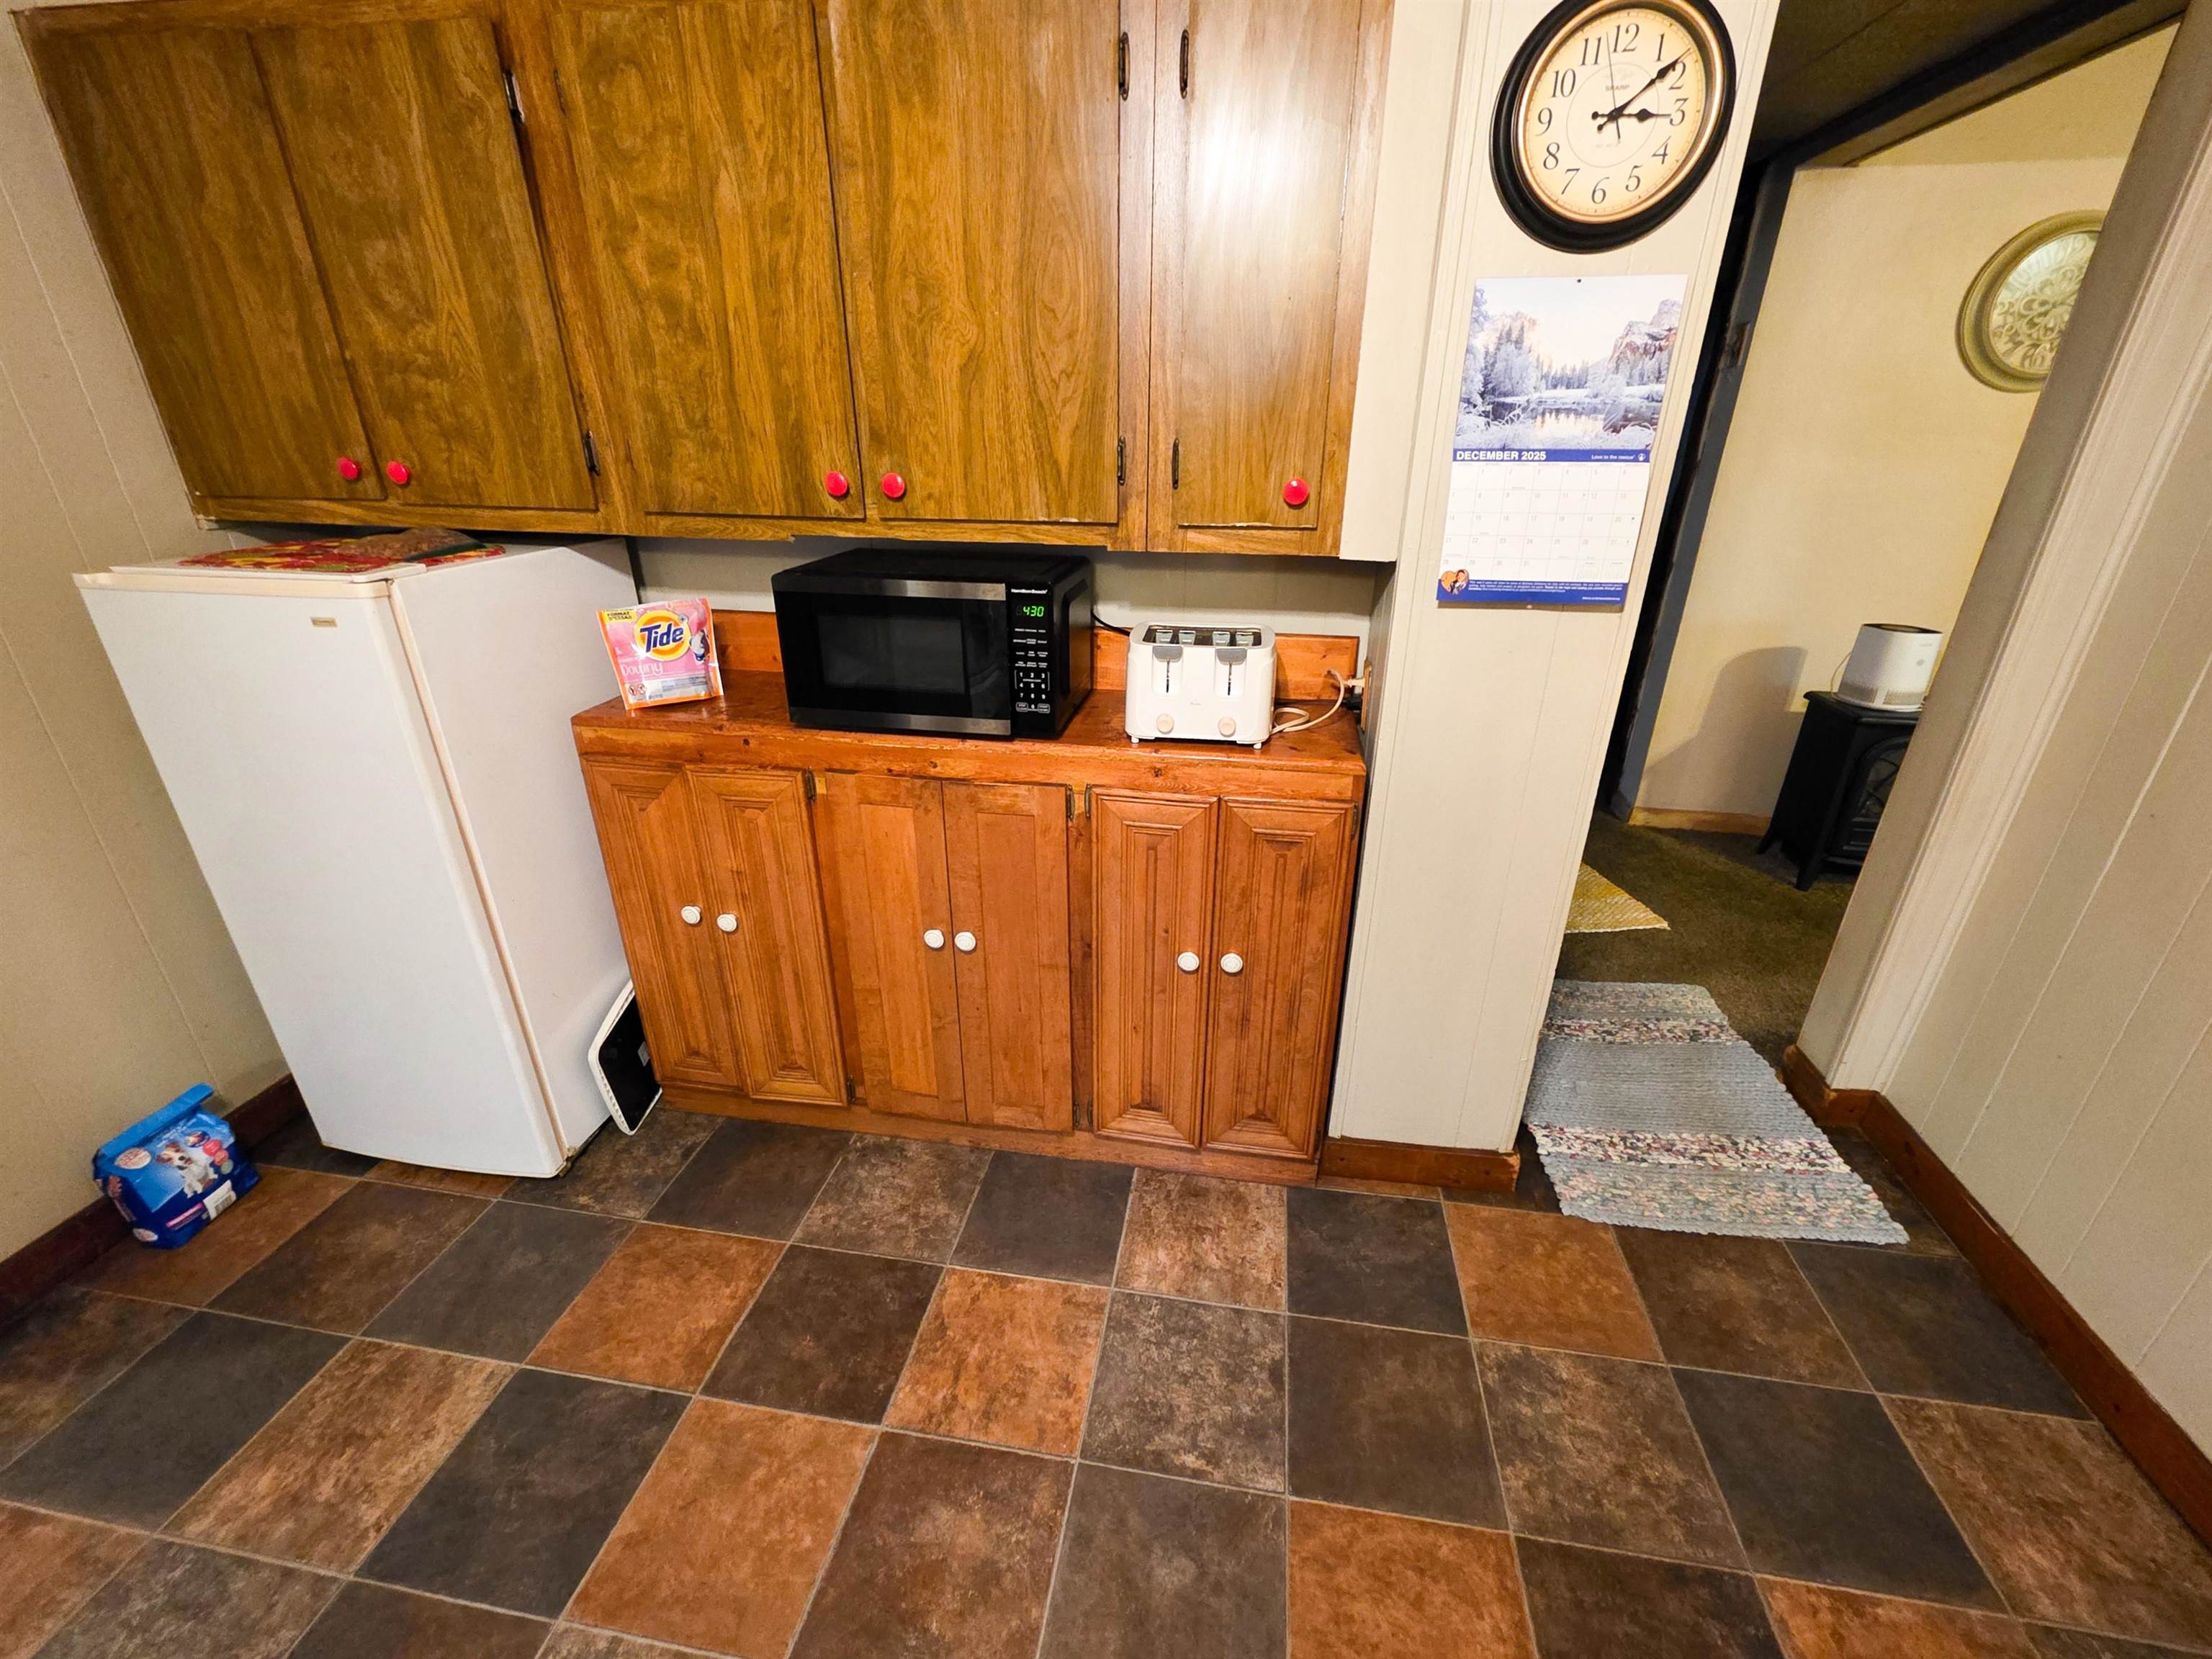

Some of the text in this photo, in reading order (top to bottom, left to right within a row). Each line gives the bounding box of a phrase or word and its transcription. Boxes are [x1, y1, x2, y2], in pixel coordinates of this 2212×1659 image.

[1578, 36, 1601, 66] 11
[1612, 22, 1640, 53] 12
[1655, 33, 1665, 62] 1
[1550, 68, 1576, 98] 10
[1668, 60, 1686, 91] 2
[1534, 107, 1552, 136] 9
[1669, 97, 1689, 127] 3
[1543, 142, 1560, 170] 8
[1651, 135, 1672, 165] 4
[1560, 168, 1581, 195] 7
[1591, 176, 1610, 204] 6
[1625, 165, 1643, 192] 5
[1456, 451, 1546, 460] DECEMBER 2025
[1023, 606, 1044, 617] 430
[639, 623, 684, 653] Tide
[619, 662, 663, 675] Downy
